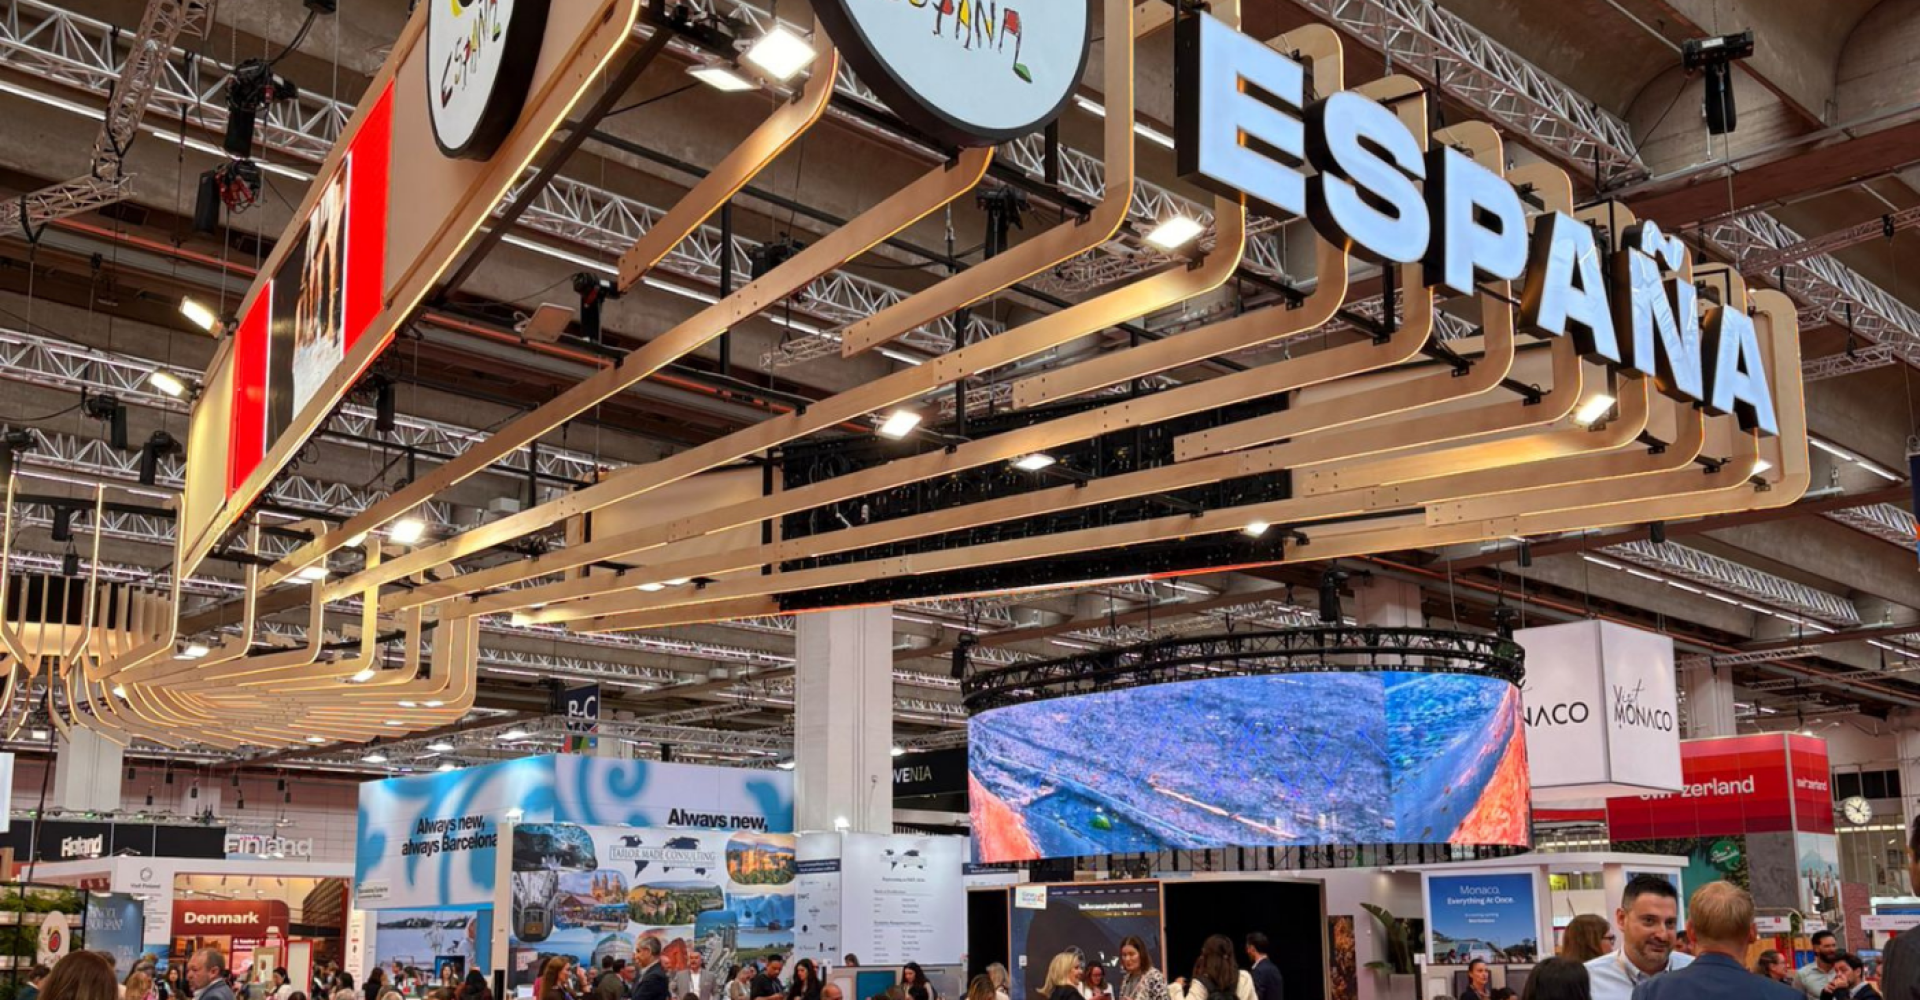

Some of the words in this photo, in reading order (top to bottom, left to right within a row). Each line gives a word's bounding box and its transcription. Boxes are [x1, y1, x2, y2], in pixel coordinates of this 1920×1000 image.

[1198, 10, 1780, 436] ESPAÑA
[1613, 704, 1673, 732] MONACO
[893, 765, 932, 784] VENIA
[416, 816, 457, 835] Always
[457, 814, 485, 832] new,
[667, 808, 728, 828] Always
[730, 815, 769, 834] new,
[401, 838, 440, 857] always
[441, 832, 497, 852] Barcelona
[1447, 896, 1485, 907] Everything
[184, 911, 260, 924] Denmark
